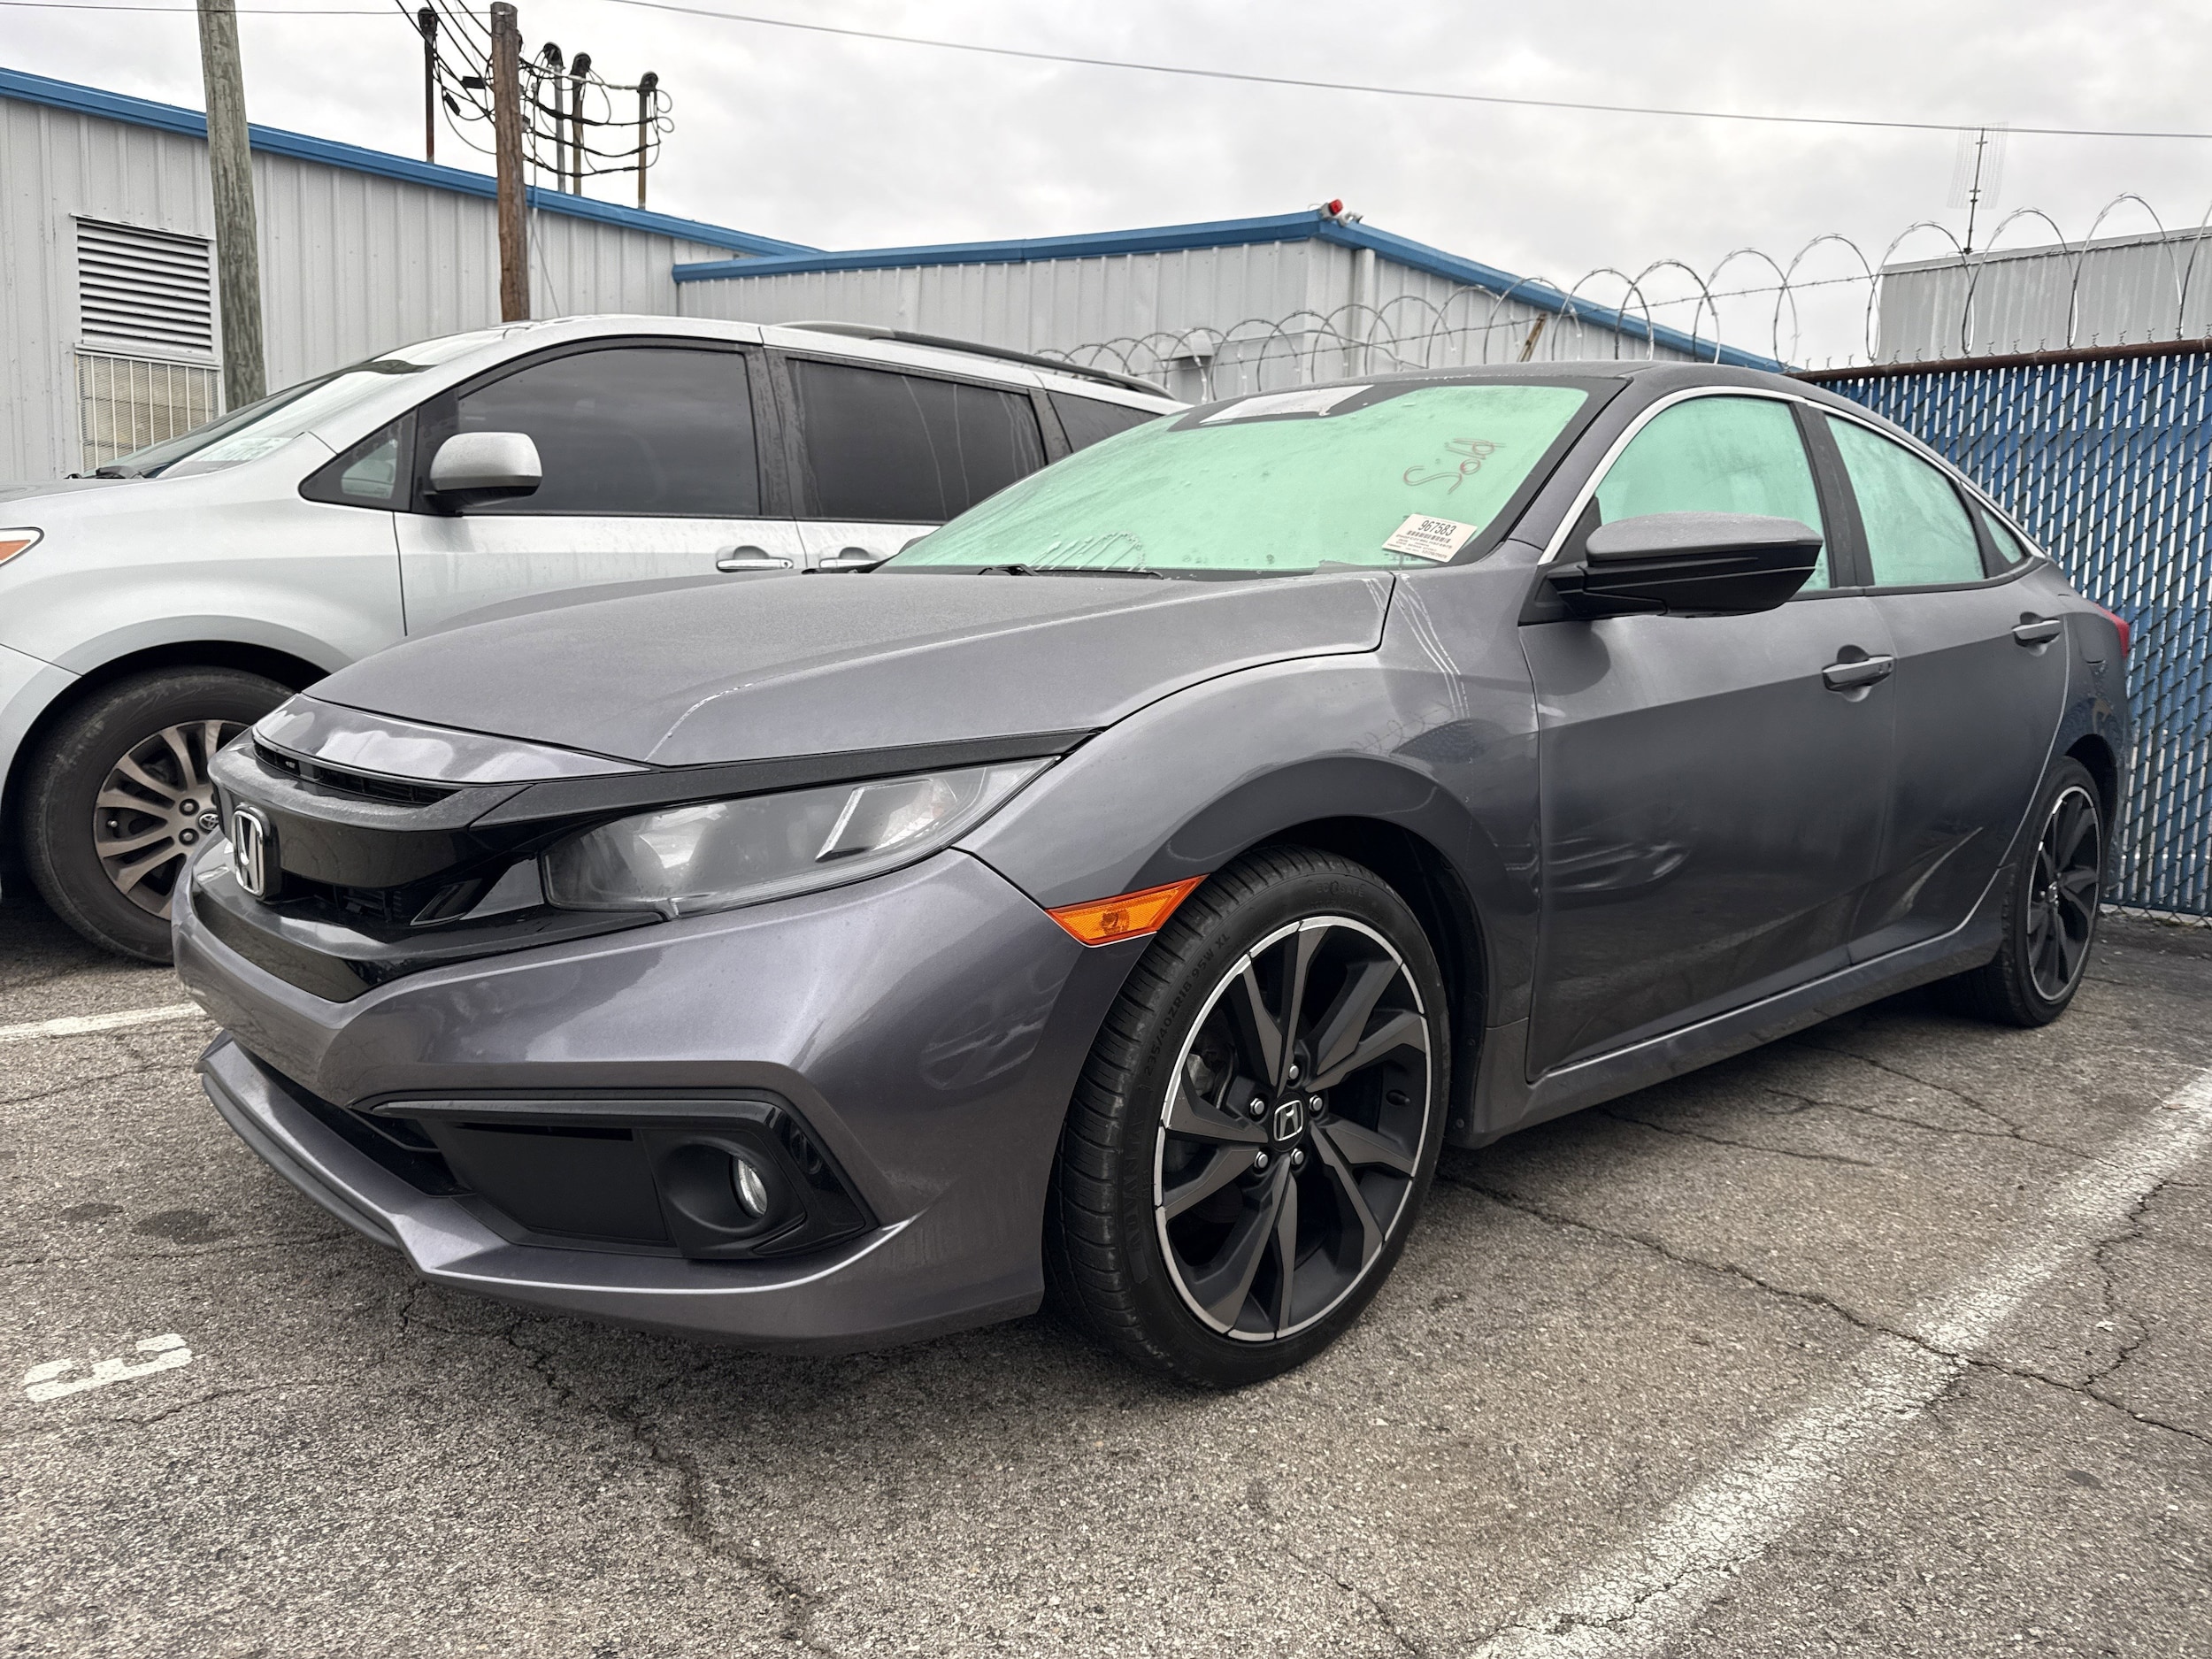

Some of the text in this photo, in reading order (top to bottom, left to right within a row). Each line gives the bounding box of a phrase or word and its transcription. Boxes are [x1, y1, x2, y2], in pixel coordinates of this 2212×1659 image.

[1403, 438, 1506, 495] Sold
[1417, 519, 1457, 536] 967583
[1144, 933, 1231, 1078] 235/40ZR18 95W XL
